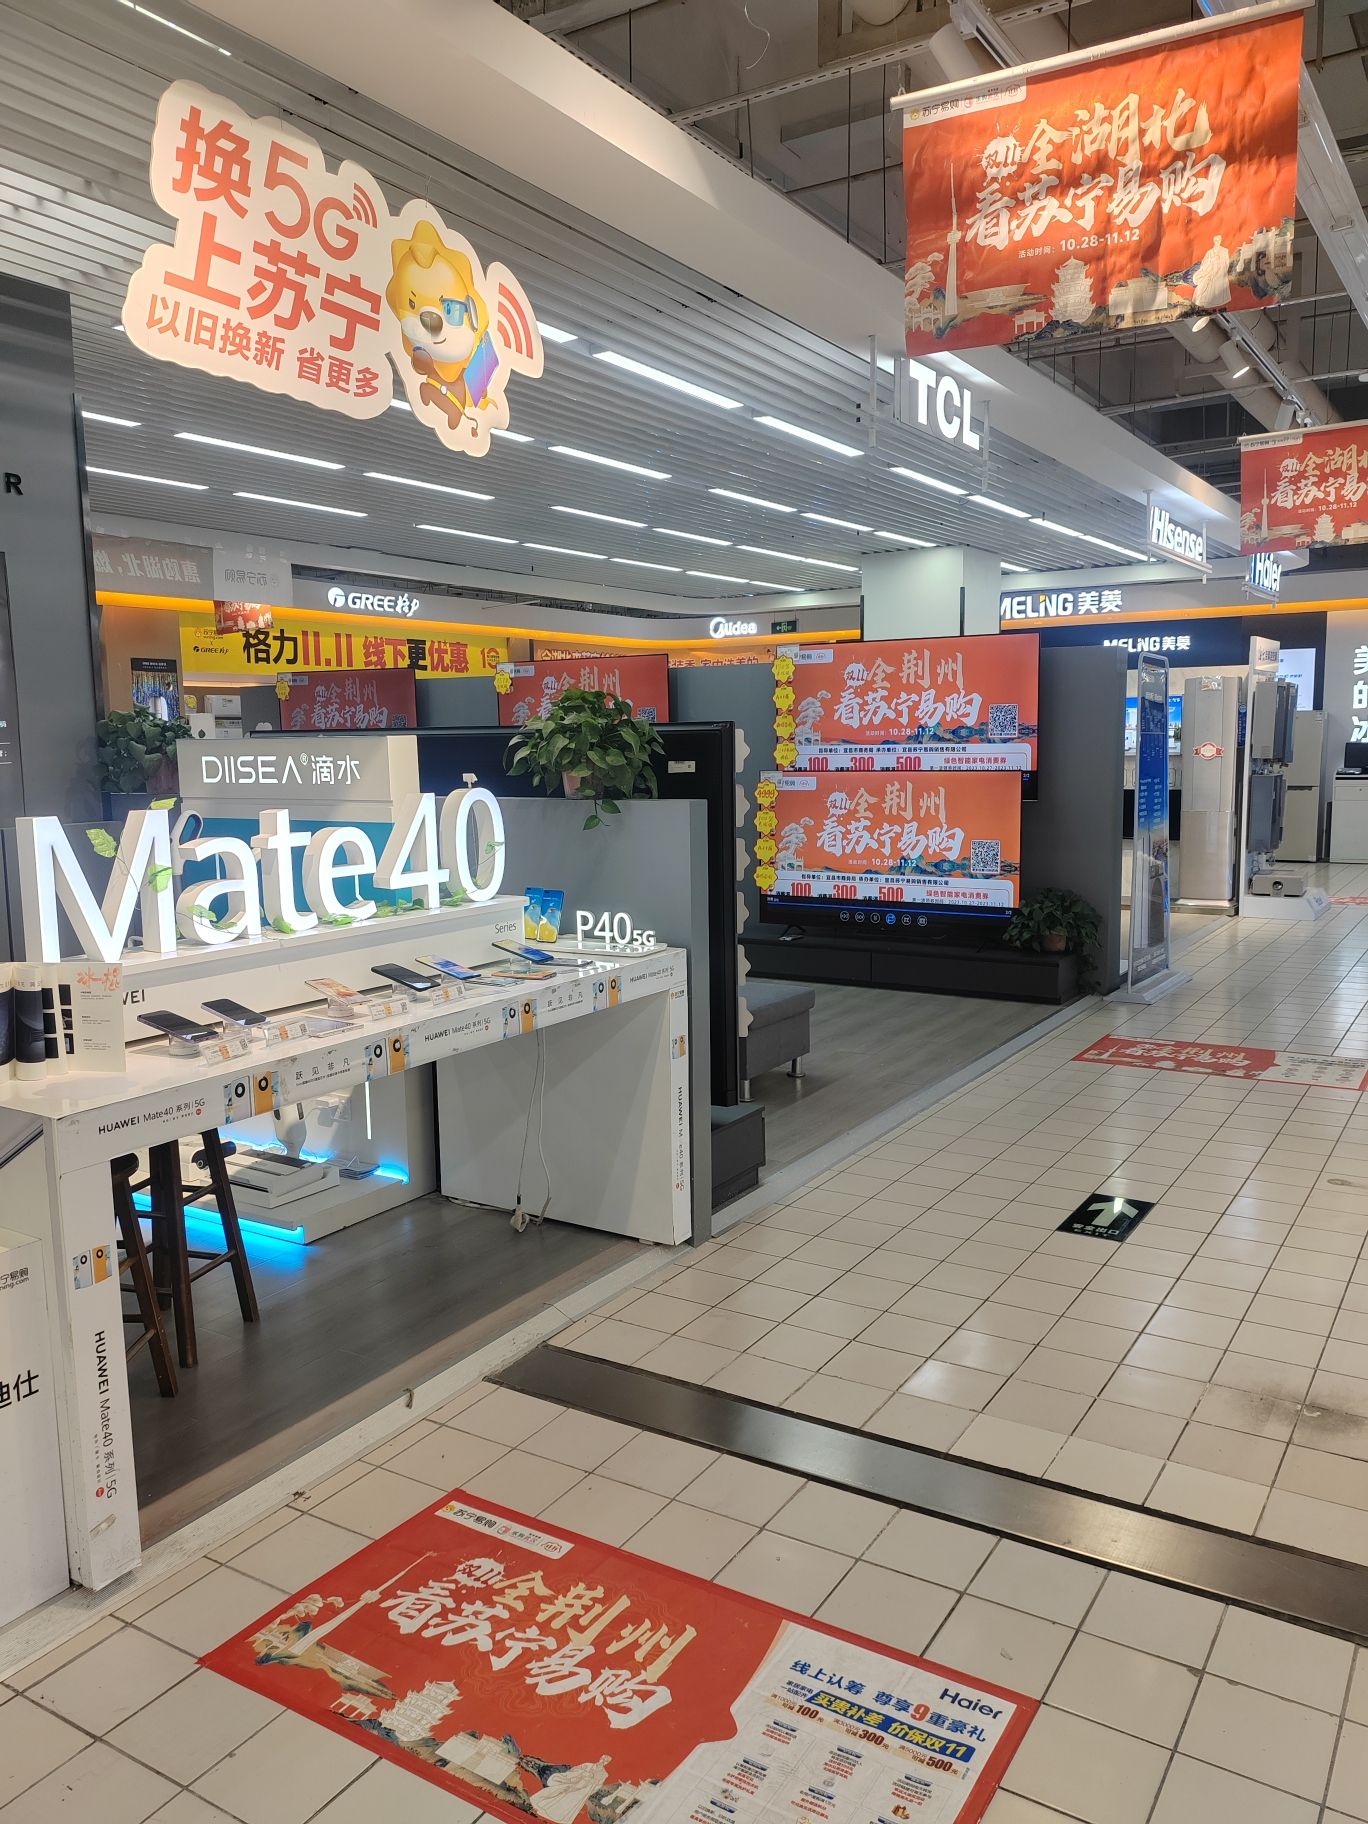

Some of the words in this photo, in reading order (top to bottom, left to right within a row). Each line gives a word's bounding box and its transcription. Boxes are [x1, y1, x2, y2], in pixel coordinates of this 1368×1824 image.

[1022, 88, 1214, 175] 全湖北
[965, 152, 1227, 251] 看苏宁易购
[1059, 228, 1140, 252] 10.28-11.12
[163, 211, 382, 352] 上苏宁
[145, 292, 286, 371] 以旧换新
[295, 346, 381, 399] 省更多
[908, 358, 980, 452] TCL
[4, 472, 24, 496] R
[1270, 471, 1368, 509] 看苏宁易
[1317, 502, 1358, 512] 10.28-11.12
[1150, 505, 1204, 561] Hisense
[1251, 551, 1282, 592] Haier
[347, 592, 397, 613] GREE
[1077, 589, 1123, 614] 美菱
[709, 616, 758, 639] Midea
[1161, 635, 1191, 651] 美菱
[362, 634, 470, 673] 线下更优惠
[867, 648, 963, 689] 全荆州
[310, 703, 390, 729] 看苏宁易购
[833, 687, 983, 730] 看苏宁易购
[889, 727, 935, 736] 10.28-11.12
[310, 754, 361, 785] 滴水
[850, 780, 946, 822] 全荆州
[816, 818, 965, 860] 看苏宁易购
[17, 786, 506, 962] Mate40
[871, 858, 917, 867] 10.28-11.12
[494, 921, 517, 936] Series
[576, 909, 632, 945] P40
[631, 929, 656, 946] 5G
[423, 1028, 451, 1043] HUAWEI
[451, 1021, 472, 1035] Mate40
[98, 1116, 141, 1136] HUAWEI
[142, 1106, 175, 1123] Mate40
[94, 1330, 109, 1396] HUAWEI
[99, 1397, 113, 1448] Mate40
[496, 1570, 697, 1684] 全荆州
[379, 1578, 673, 1729] 看苏宁易购
[789, 1659, 867, 1696] 线上认筹
[871, 1689, 987, 1743] 尊享9重豪礼
[938, 1687, 1004, 1720] Haier
[811, 1691, 886, 1728] 买贵补差
[887, 1720, 969, 1759] 价保双11
